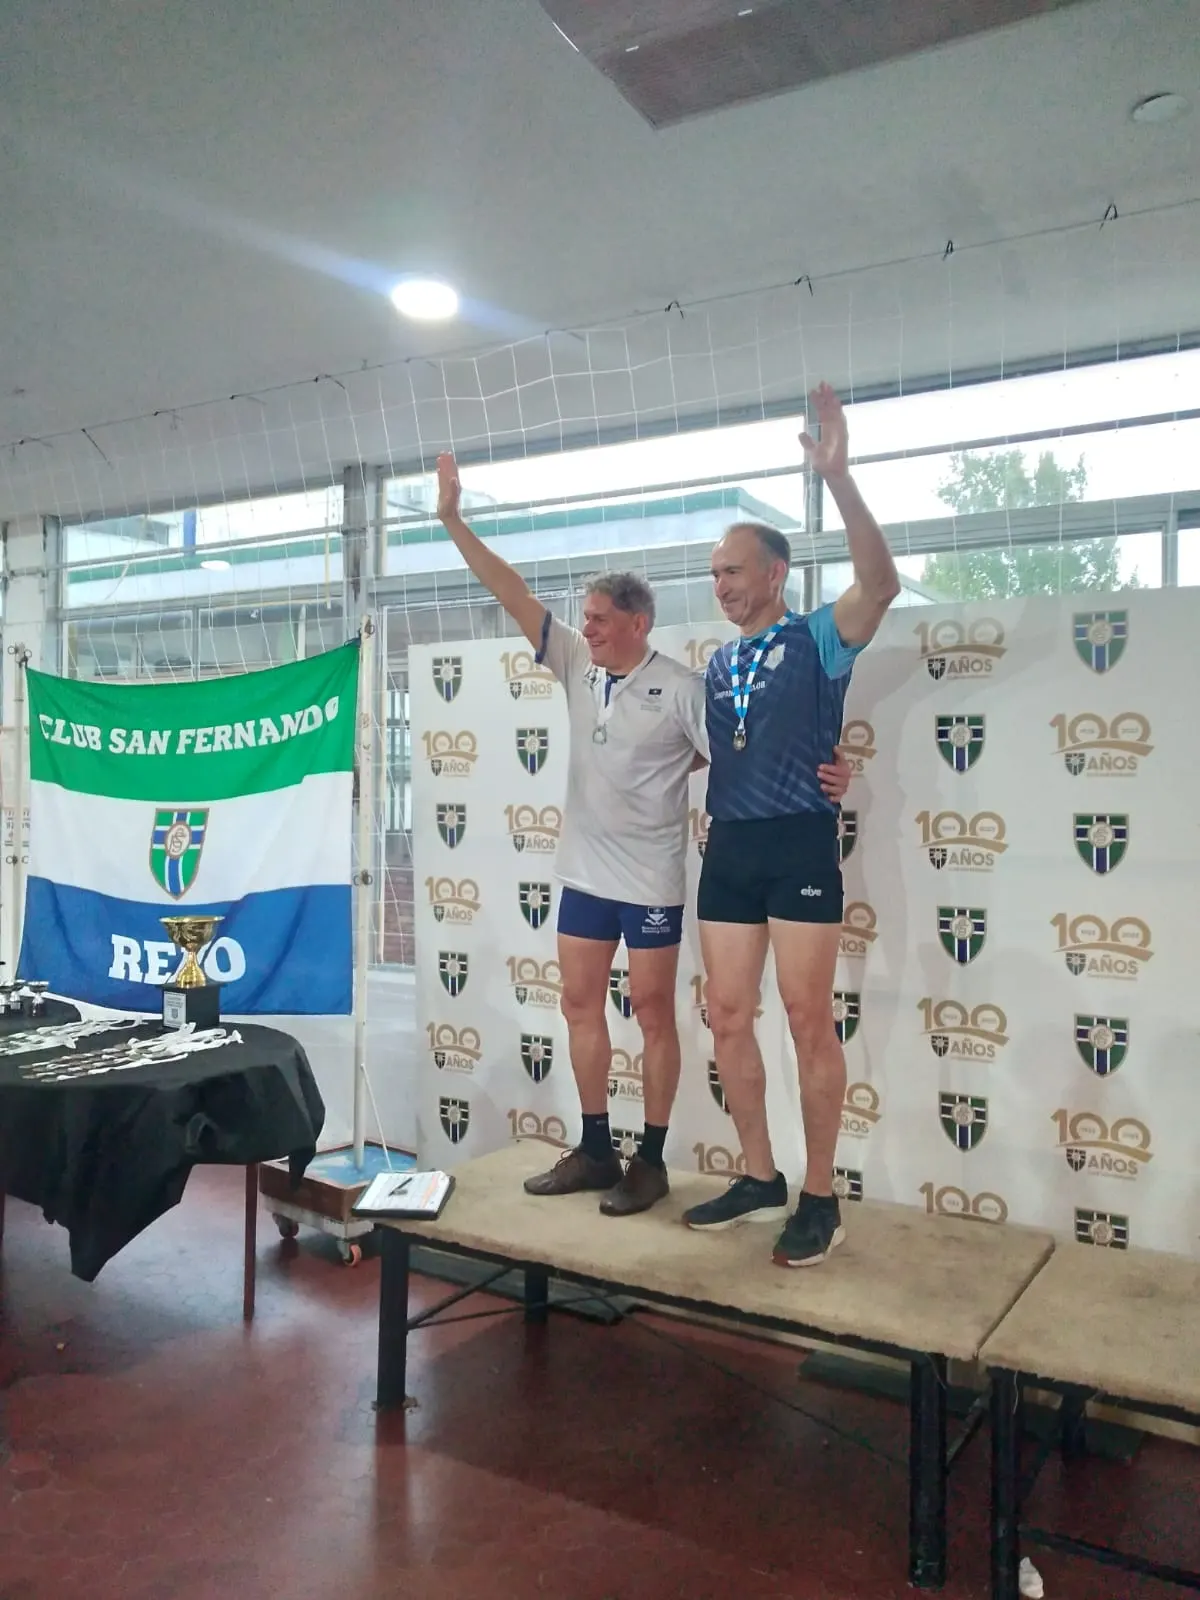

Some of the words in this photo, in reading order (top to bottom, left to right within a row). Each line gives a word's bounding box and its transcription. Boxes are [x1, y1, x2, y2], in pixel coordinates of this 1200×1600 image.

[912, 616, 1005, 655] 100
[499, 651, 541, 680] 10
[684, 638, 722, 669] 10
[947, 654, 993, 674] AÑOS
[522, 680, 553, 696] AÑOS
[38, 713, 102, 751] CLUB
[108, 727, 172, 755] SAN
[175, 695, 340, 755] FERNANDO
[1048, 711, 1152, 749] 100
[421, 730, 477, 756] 100
[442, 758, 471, 773] AÑOS
[1086, 751, 1138, 771] AÑOS
[503, 804, 562, 831] 100
[914, 810, 1006, 844] 100
[526, 834, 556, 850] AÑOS
[948, 847, 995, 866] AÑOS
[424, 876, 480, 902] 100
[445, 905, 473, 921] AÑOS
[1049, 912, 1152, 949] 100
[840, 936, 866, 953] ÑOS
[1087, 953, 1139, 975] AÑOS
[528, 987, 558, 1005] AÑOS
[916, 997, 1007, 1033] 100
[426, 1021, 481, 1050] 100
[950, 1037, 996, 1058] AÑOS
[446, 1053, 474, 1070] AÑOS
[618, 1080, 643, 1098] AÑO
[507, 1109, 567, 1140] 100
[841, 1114, 870, 1134] ÑOS
[1050, 1108, 1152, 1150] 100
[1087, 1152, 1139, 1175] AÑOS
[918, 1182, 1008, 1223] 100
